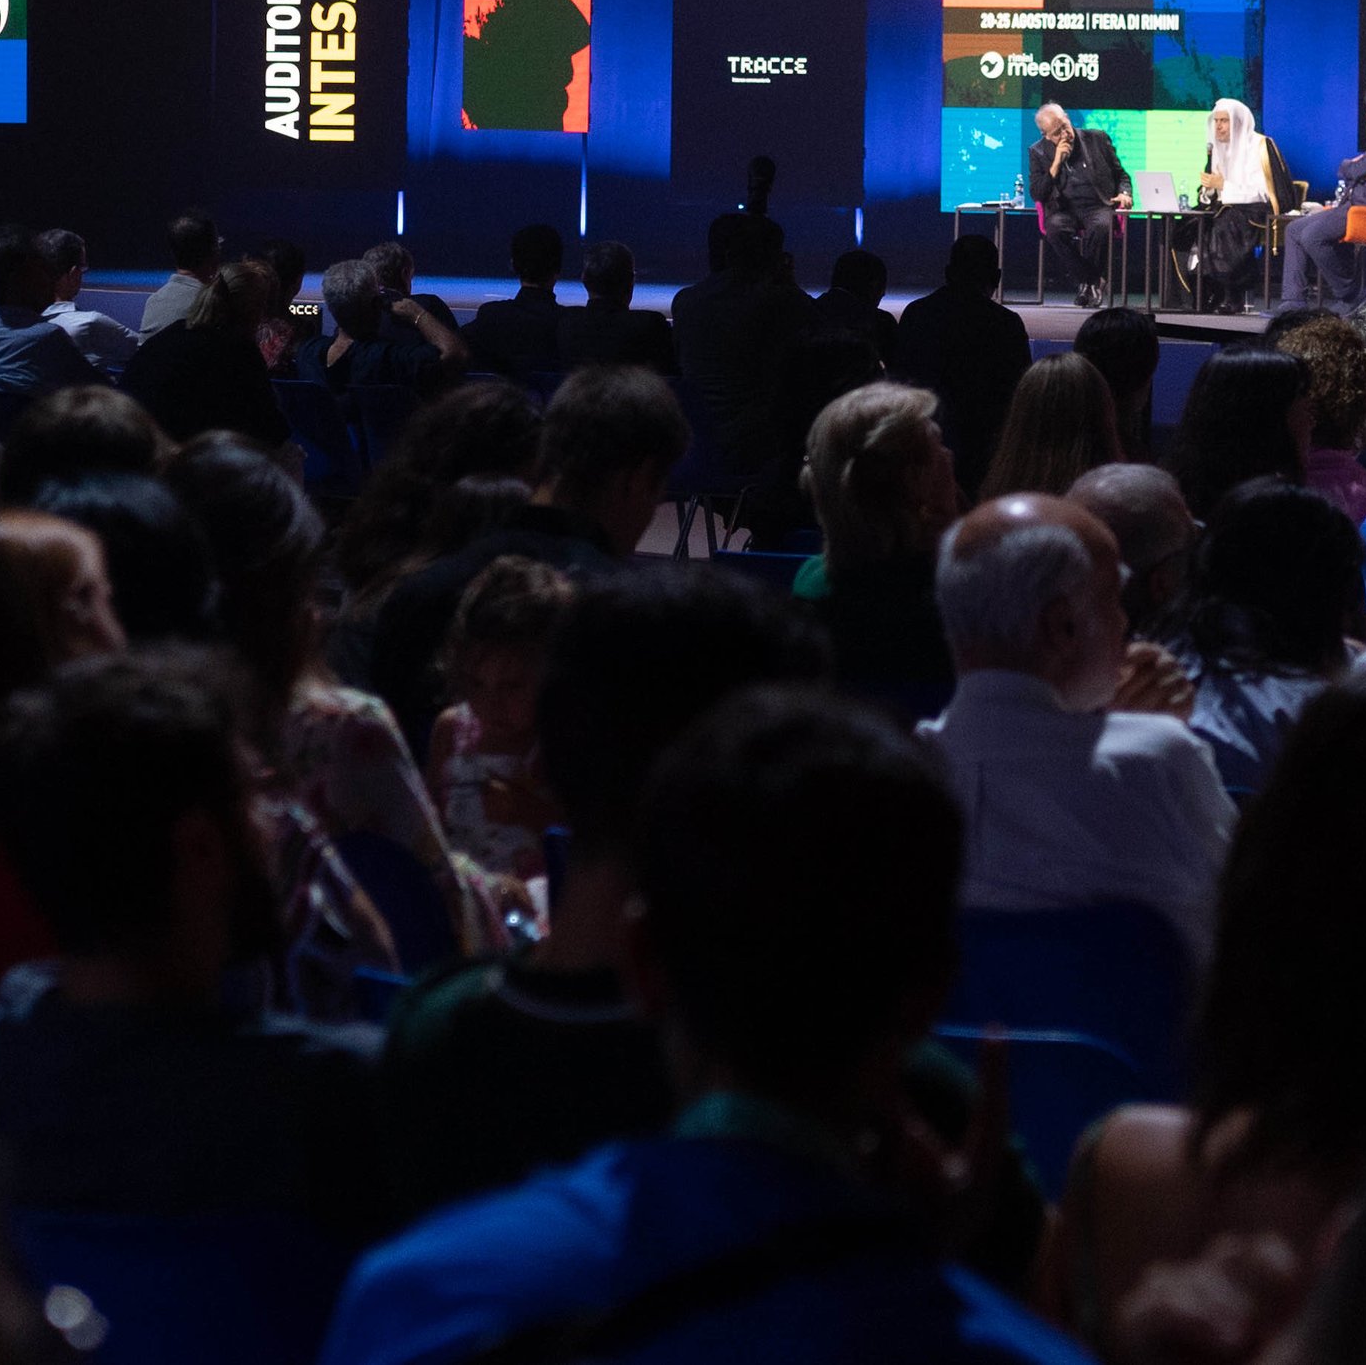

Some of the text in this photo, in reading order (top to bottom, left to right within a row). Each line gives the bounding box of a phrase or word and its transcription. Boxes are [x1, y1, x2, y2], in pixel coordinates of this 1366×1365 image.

[1011, 12, 1056, 30] AGOSTO
[1057, 13, 1084, 30] 2022
[1092, 13, 1126, 30] FIERA
[1127, 14, 1140, 30] DI
[1141, 14, 1179, 31] RIMINI
[727, 56, 807, 74] TRACCE
[1007, 56, 1099, 81] meeting
